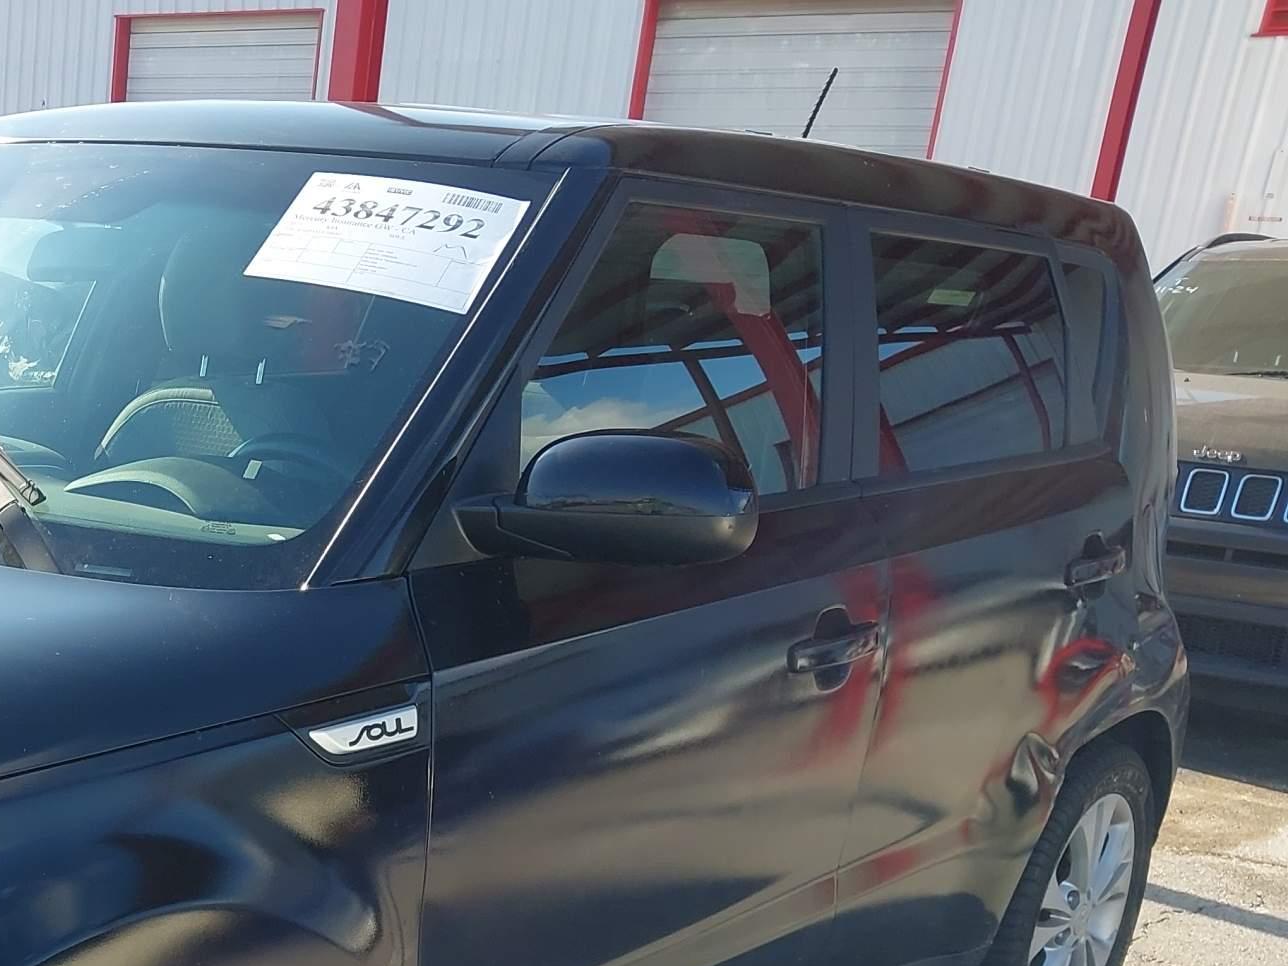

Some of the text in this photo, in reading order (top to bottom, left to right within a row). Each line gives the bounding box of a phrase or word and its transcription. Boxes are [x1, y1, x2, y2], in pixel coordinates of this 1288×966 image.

[312, 196, 486, 239] 43847292
[1193, 445, 1243, 463] Jeep
[348, 717, 415, 747] SOUL
